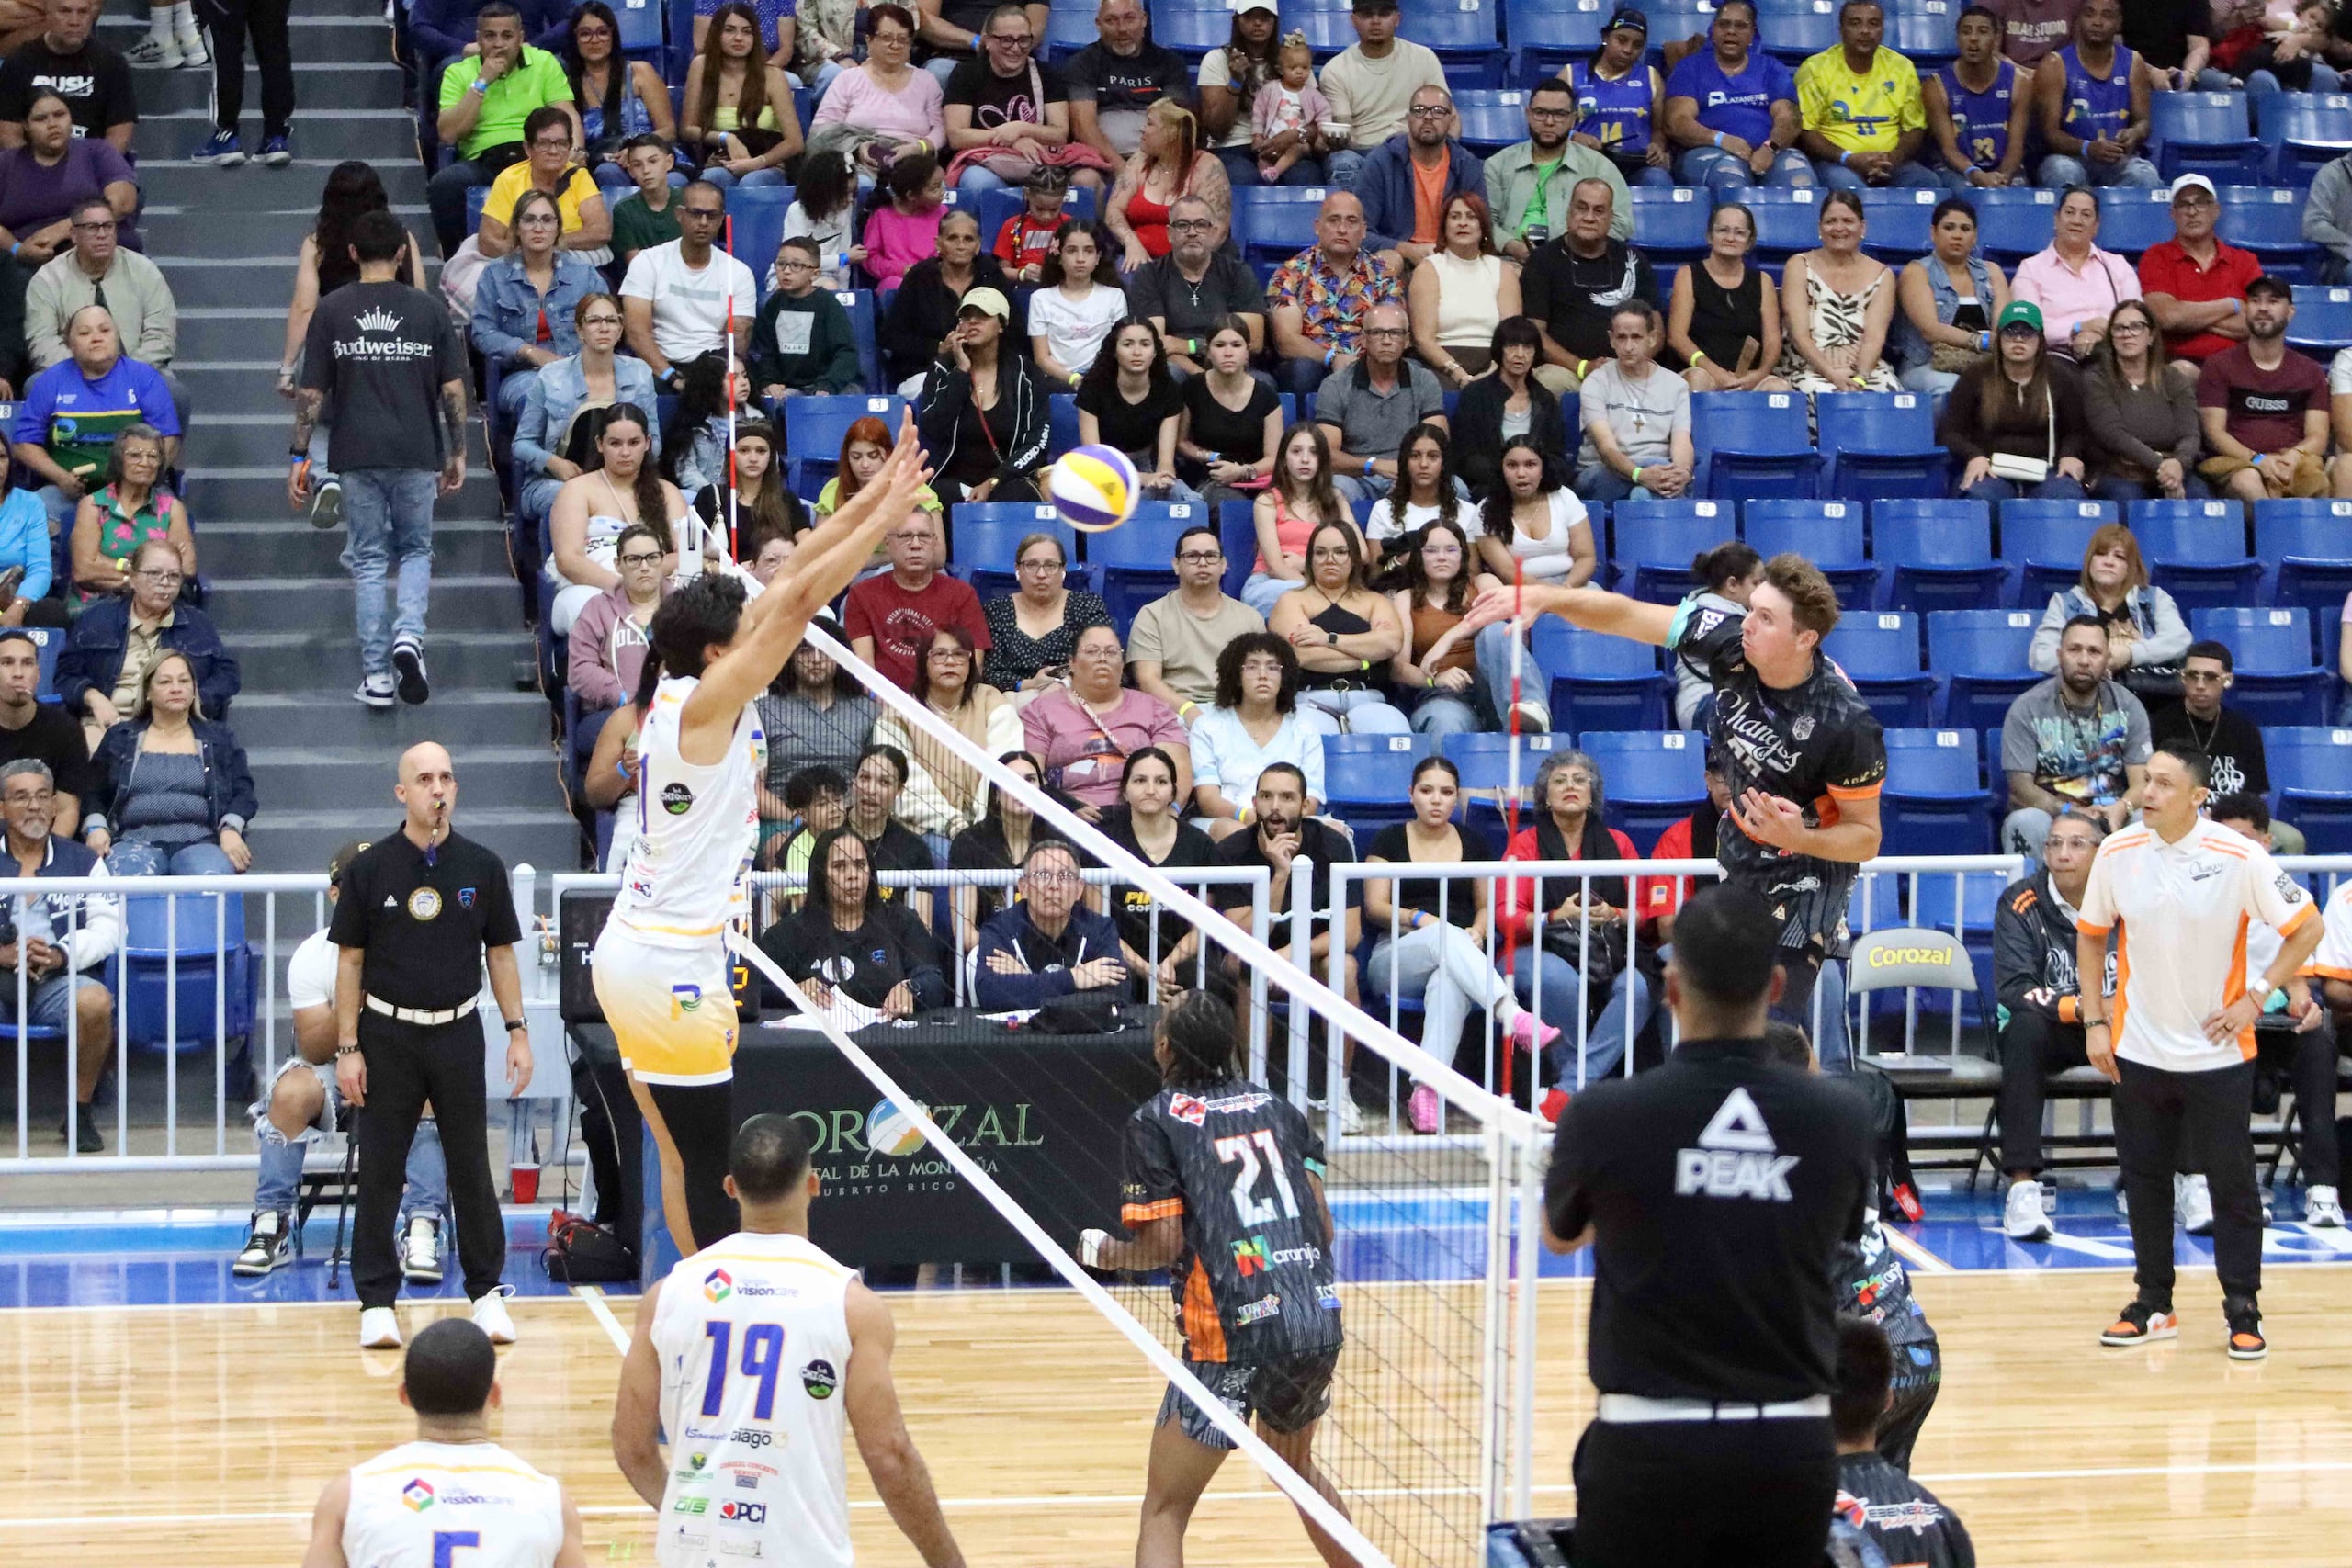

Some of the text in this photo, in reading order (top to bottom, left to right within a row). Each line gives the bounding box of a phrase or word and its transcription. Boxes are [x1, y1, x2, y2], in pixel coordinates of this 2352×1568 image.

[1109, 75, 1152, 88] PARIS
[332, 336, 433, 359] Budweiser
[2245, 396, 2289, 411] GUESS
[1715, 688, 1802, 770] Changos
[1869, 946, 1952, 968] Corozal
[739, 1102, 1045, 1156] OROZAL
[850, 1165, 871, 1179] DE
[878, 1163, 900, 1177] LA
[1214, 1129, 1300, 1228] 21
[1675, 1147, 1802, 1202] PEAK
[823, 1181, 956, 1197] UERTO RICO
[737, 1286, 800, 1297] visioncare
[701, 1321, 785, 1420] 19
[736, 1501, 767, 1524] PCI
